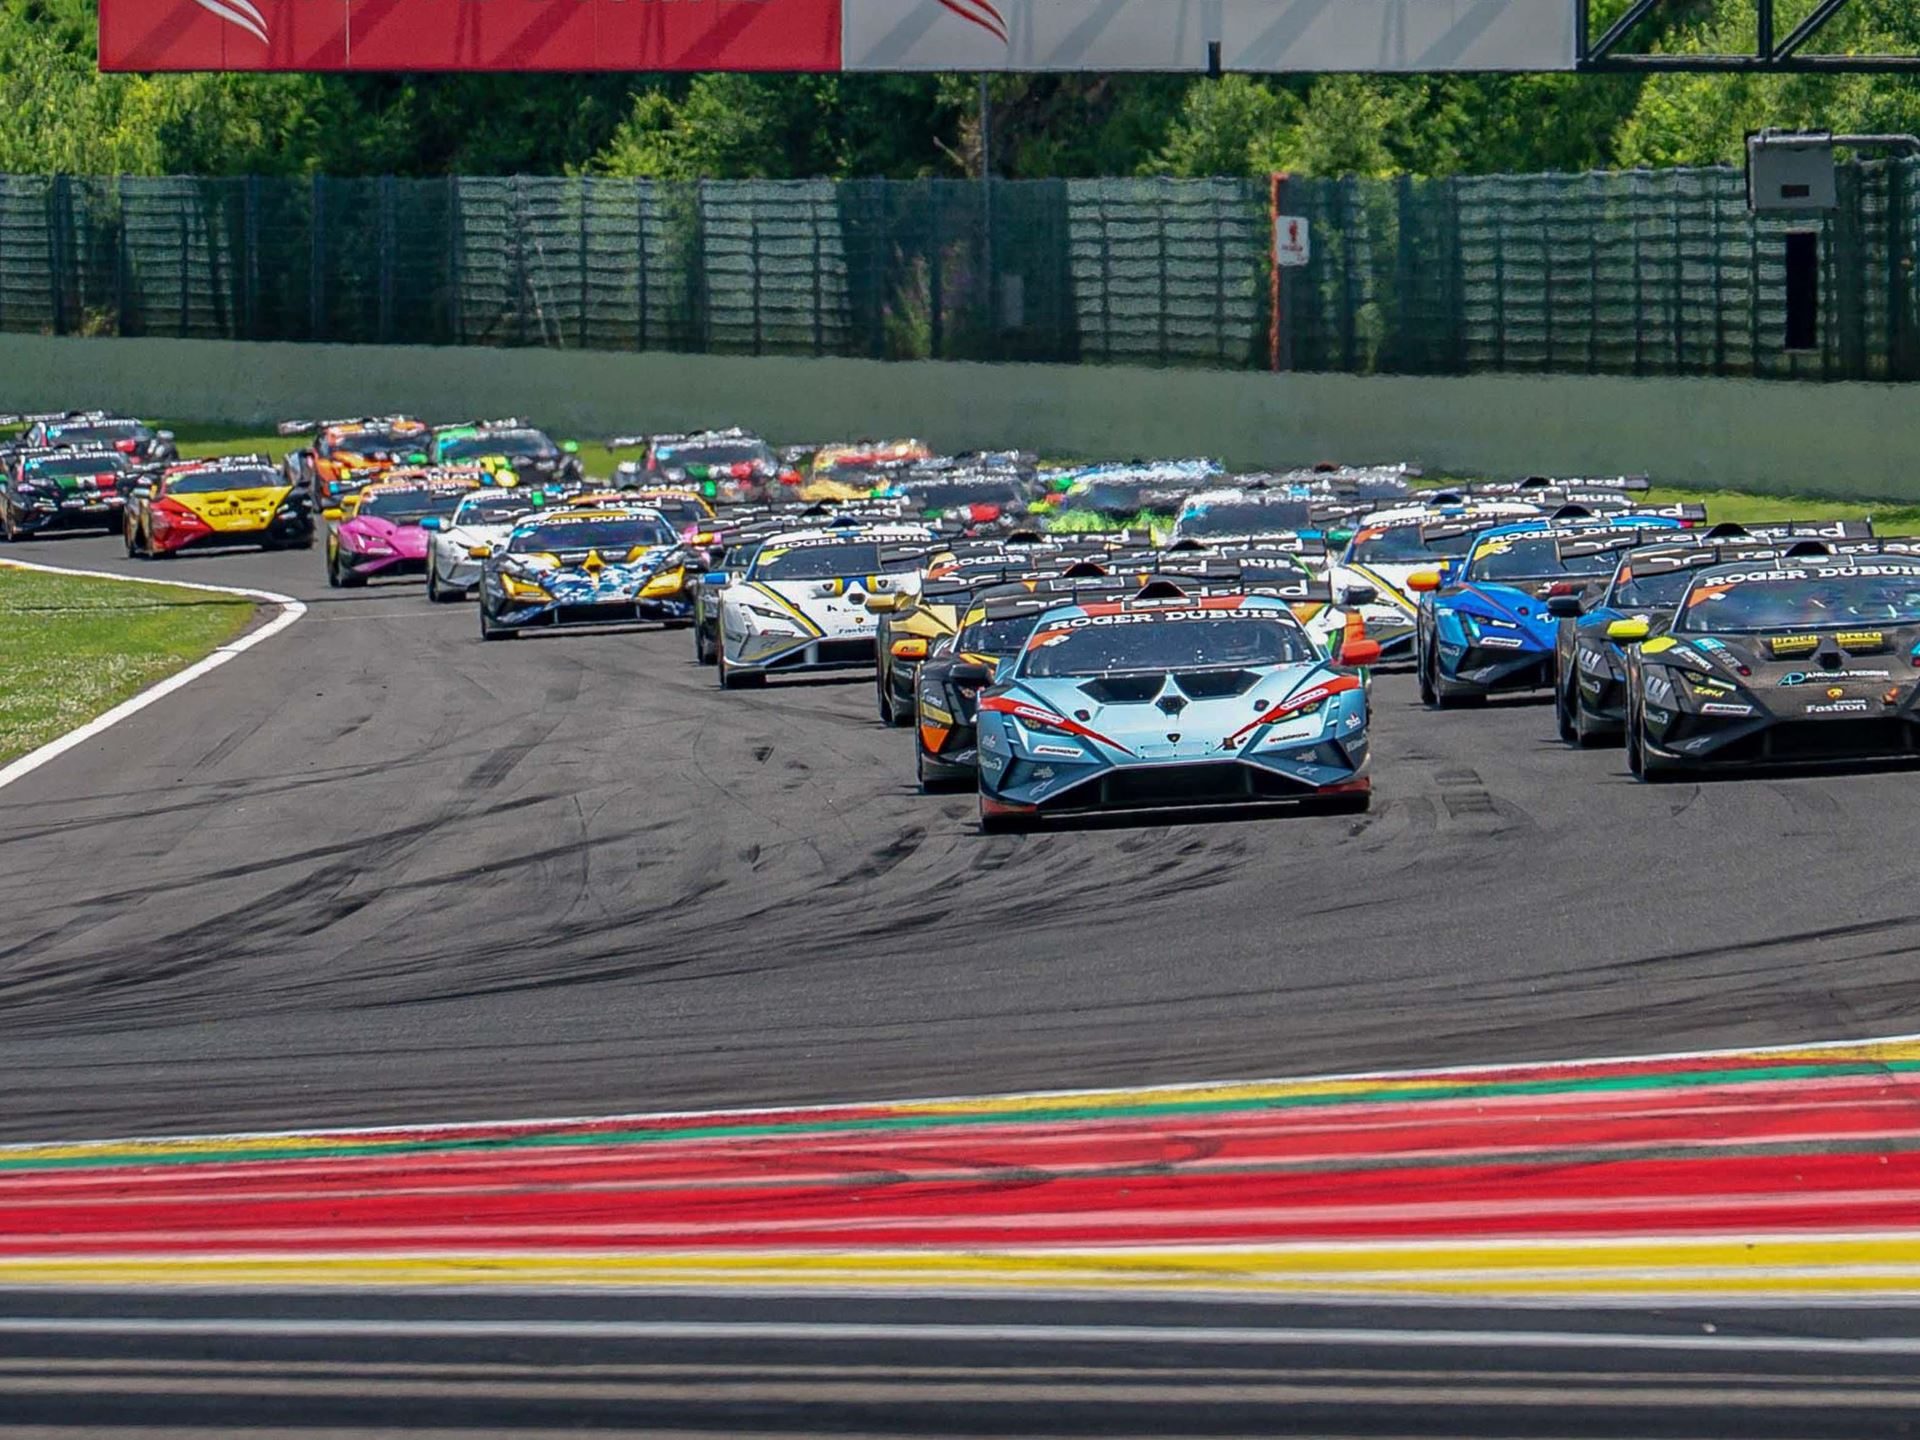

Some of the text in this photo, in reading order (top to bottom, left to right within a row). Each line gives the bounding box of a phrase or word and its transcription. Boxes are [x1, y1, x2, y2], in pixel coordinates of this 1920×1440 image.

[773, 534, 932, 550] ROGER DUBUIS
[1704, 569, 1809, 587] ROGER
[1048, 608, 1280, 631] ROGER DUBUIS
[1806, 703, 1867, 713] Fastron
